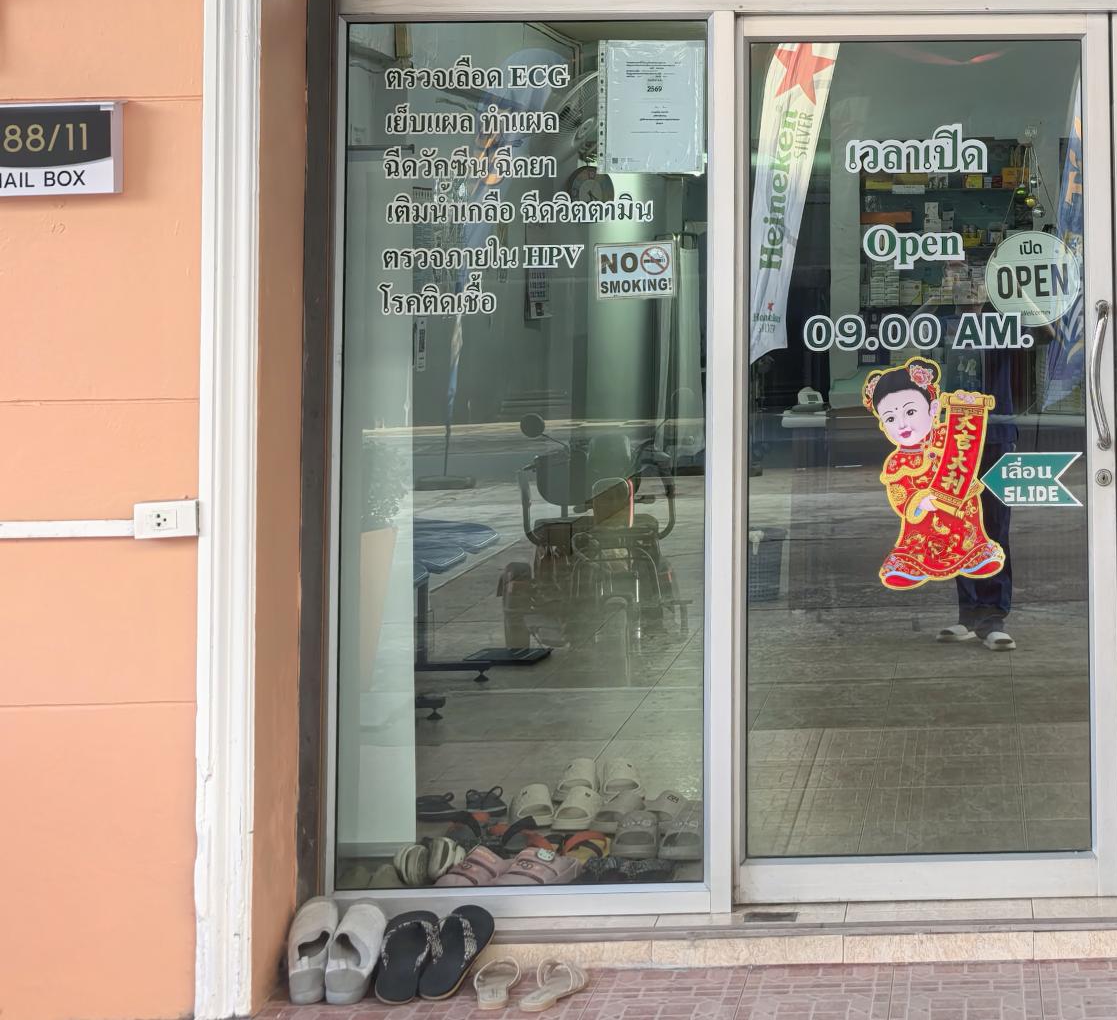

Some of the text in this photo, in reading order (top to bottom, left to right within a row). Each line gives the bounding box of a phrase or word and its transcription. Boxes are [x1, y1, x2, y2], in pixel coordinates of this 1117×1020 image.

[386, 55, 570, 89] ตรวจเลือด ECG
[385, 104, 559, 133] เย็บแผล ทำแผล
[384, 146, 556, 179] ฉีดวัคซีน ฉีดยา
[846, 123, 987, 173] เวลาเปิด
[0, 170, 86, 188] AIL BOX
[759, 108, 814, 270] Heineken SILVER
[386, 182, 653, 224] เติมน้ำเกลือ ฉีดวิตตามิน
[383, 236, 584, 270] ตรวจภายใน HPV
[601, 252, 638, 274] NO
[863, 224, 965, 269] Open
[1020, 240, 1042, 255] เปิด
[379, 272, 497, 315] โรคติดเชื้อ
[600, 278, 673, 295] SMOKING!
[997, 263, 1070, 299] OPEN
[803, 314, 941, 351] 09.00
[952, 312, 1034, 349] AM.
[941, 410, 977, 494] 大吉大利
[1001, 457, 1052, 479] เลื่อน
[1004, 485, 1059, 502] SLIDE
